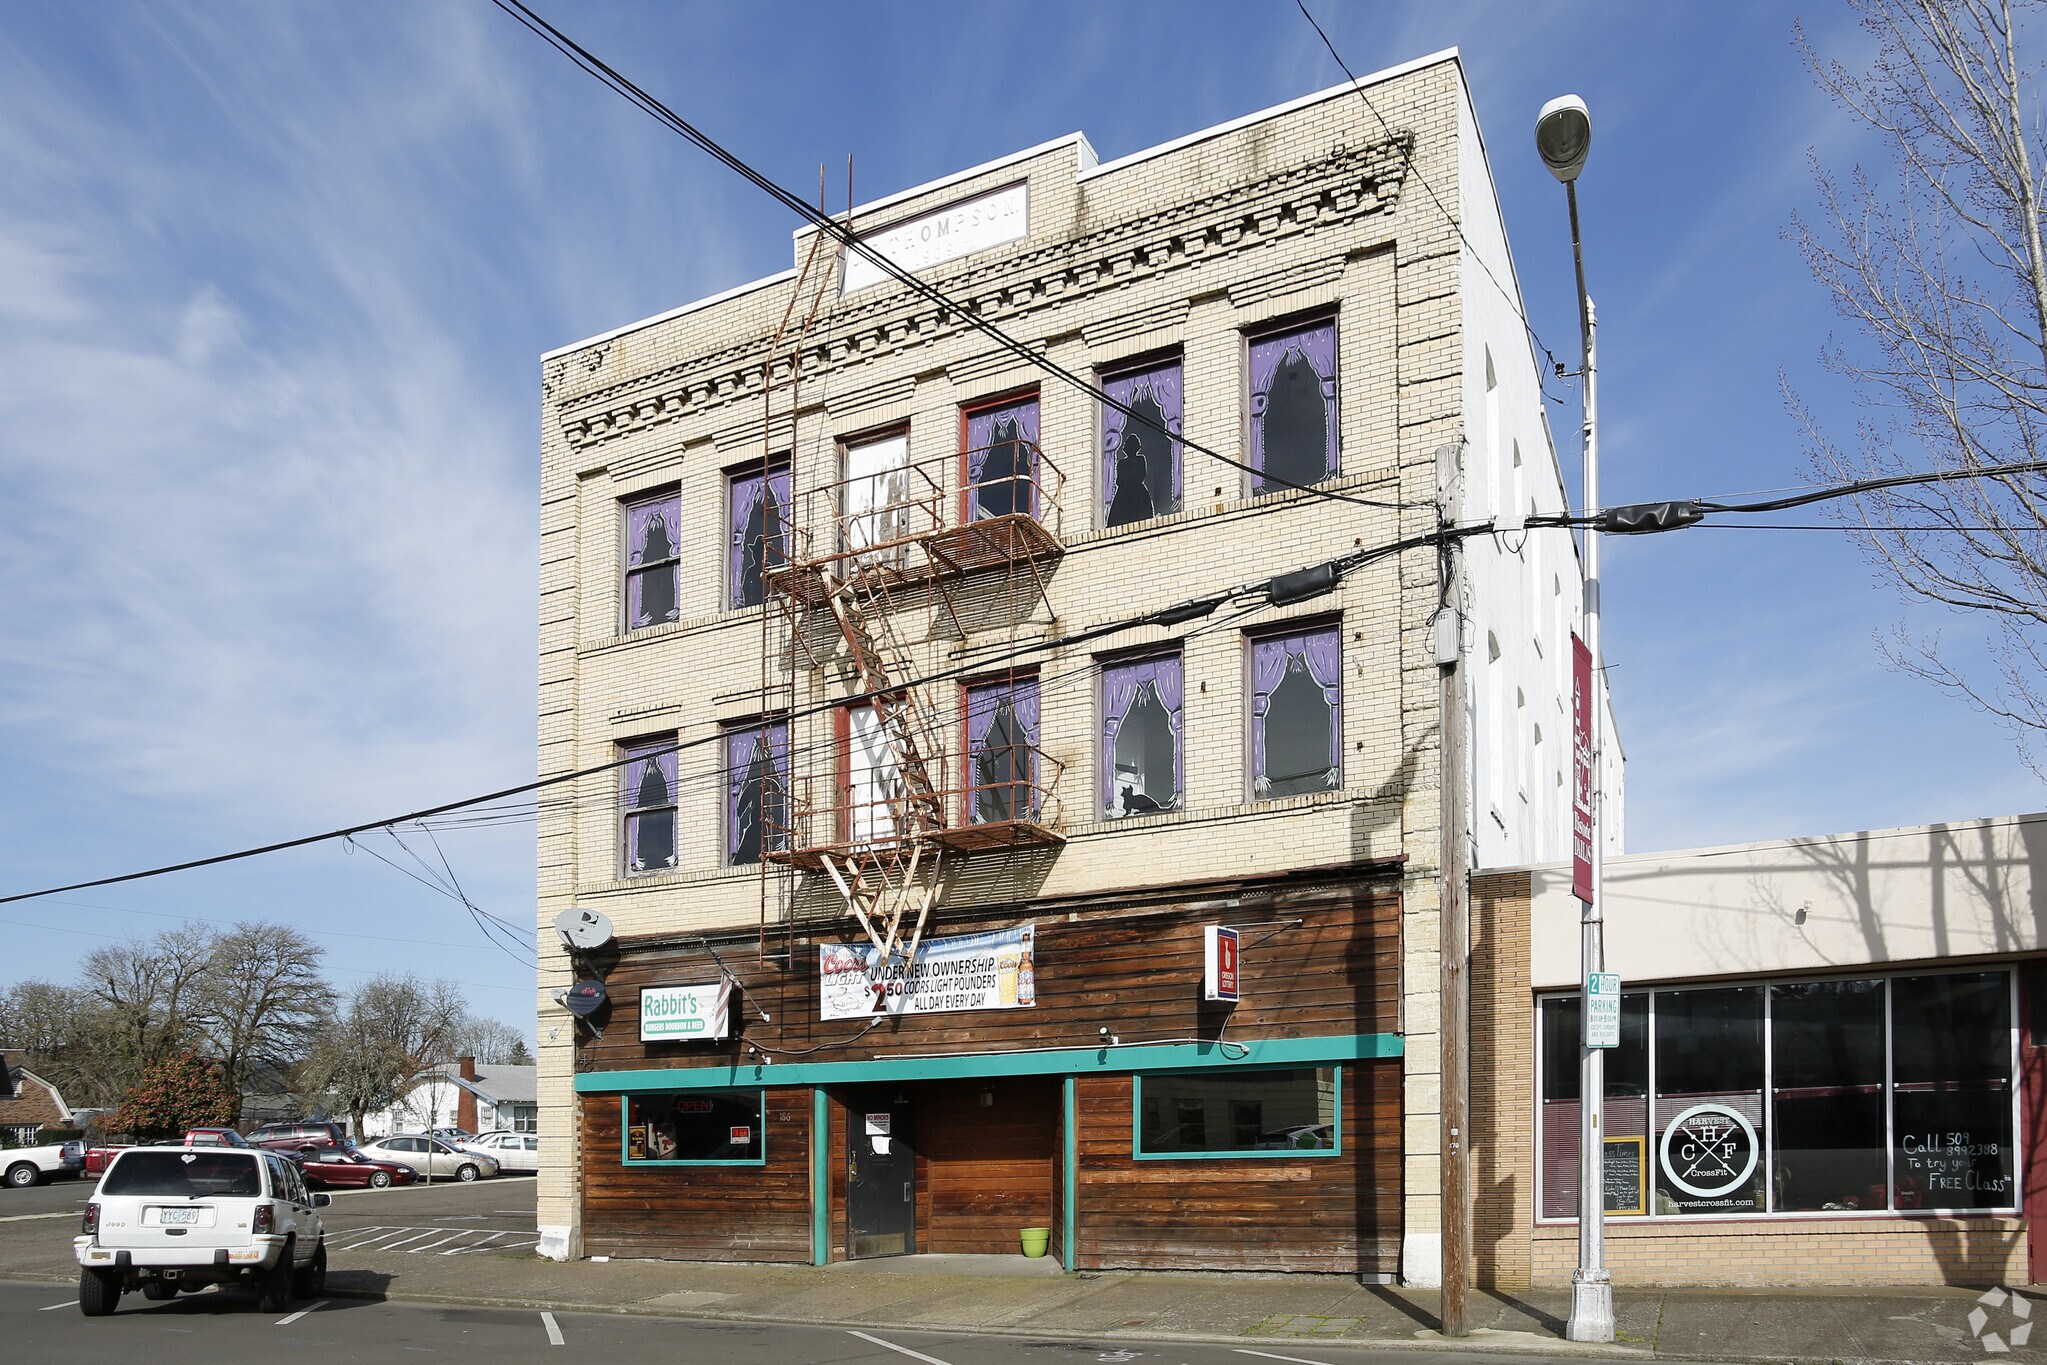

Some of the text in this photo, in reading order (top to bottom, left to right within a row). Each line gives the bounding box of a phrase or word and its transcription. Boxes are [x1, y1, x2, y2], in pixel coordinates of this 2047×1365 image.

[823, 953, 869, 975] Coors
[870, 957, 995, 982] UNDER NEW OWNERSHIP
[824, 971, 867, 987] LIGHT
[904, 979, 930, 995] COORS
[930, 977, 954, 993] LIGHT
[953, 974, 997, 991] POUNDERS
[1591, 975, 1618, 993] 2 HOUR
[644, 992, 698, 1017] Rabbit's
[914, 992, 987, 1011] ALL DAY EVERY DAY
[1590, 999, 1617, 1013] PARKING
[664, 1020, 687, 1031] BOURBON
[1688, 1116, 1731, 1126] HARVEST
[1700, 1126, 1719, 1143] H
[1681, 1142, 1737, 1161] C F
[1902, 1132, 1970, 1155] Call 509
[1690, 1168, 1728, 1178] CrossFit
[1906, 1157, 1977, 1172] To try your
[1964, 1169, 2005, 1192] Class
[1667, 1198, 1754, 1208] harvestcrossfit.com
[163, 1208, 197, 1220] YYC 589
